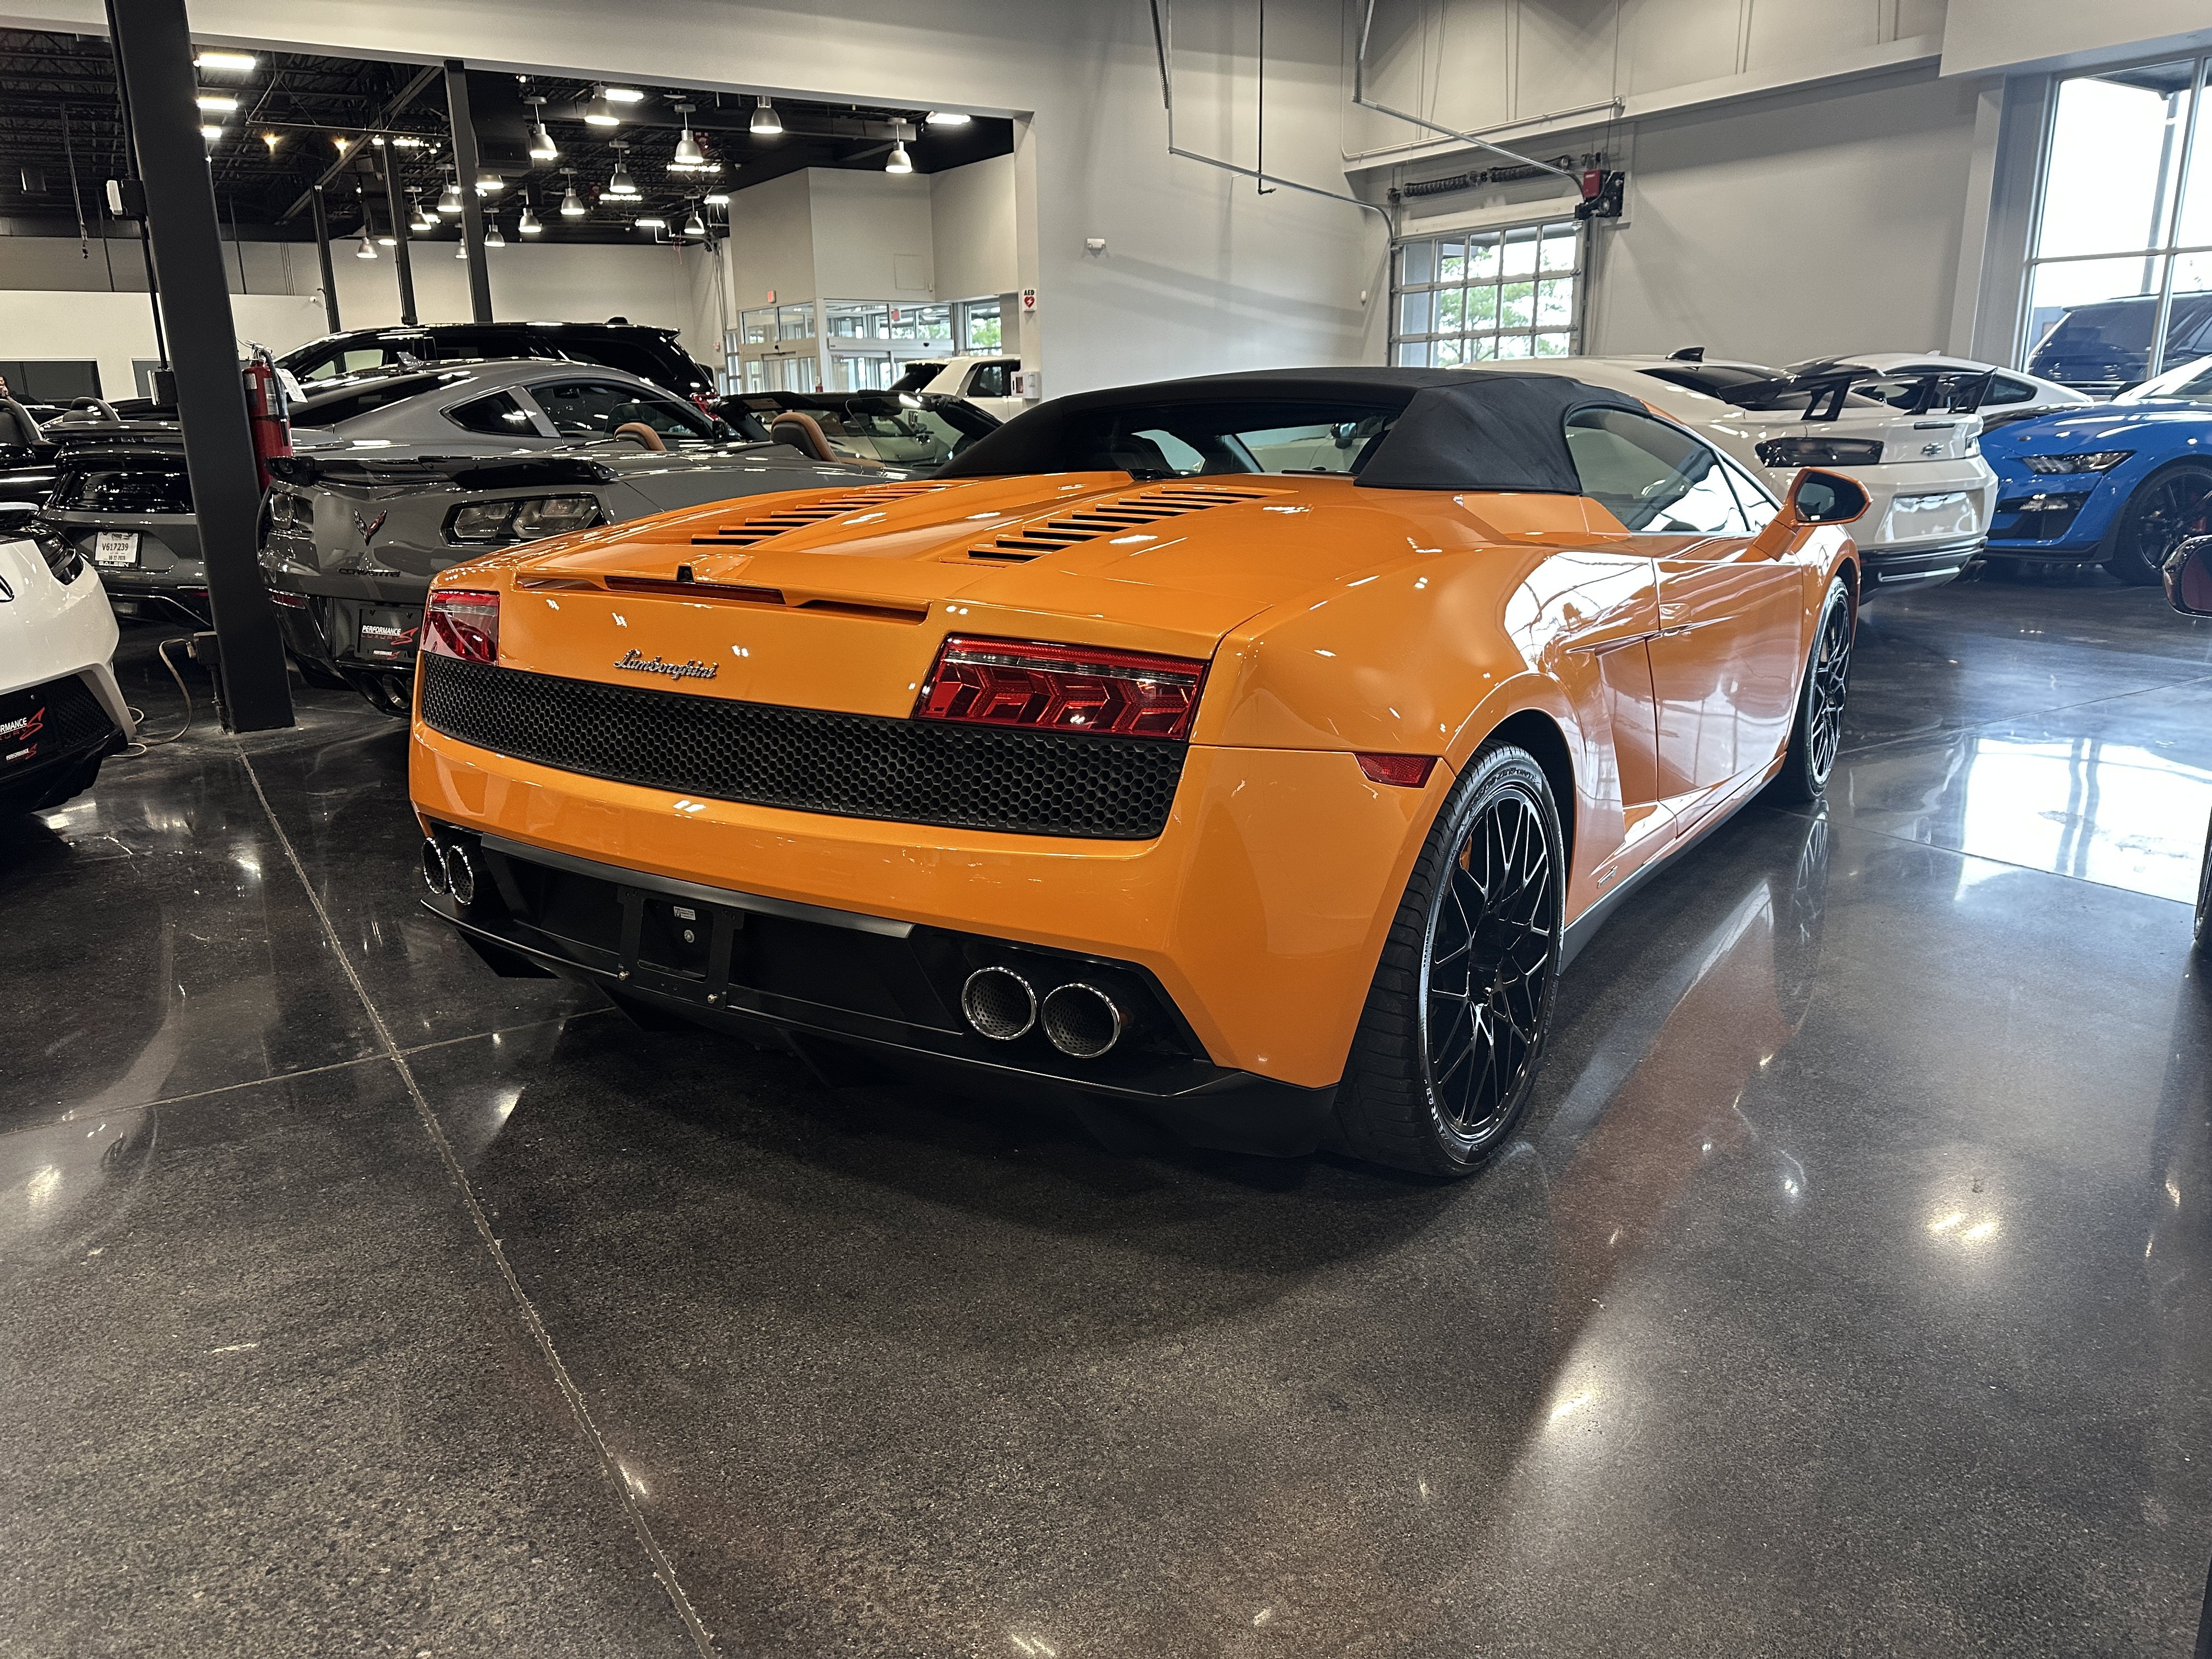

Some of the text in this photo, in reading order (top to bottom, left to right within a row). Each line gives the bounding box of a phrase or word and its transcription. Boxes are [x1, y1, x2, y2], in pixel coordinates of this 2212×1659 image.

[102, 543, 129, 551] V617239
[362, 625, 401, 635] PERFORMANCE
[613, 649, 718, 680] Lamborghini
[0, 717, 27, 733] RMANCE
